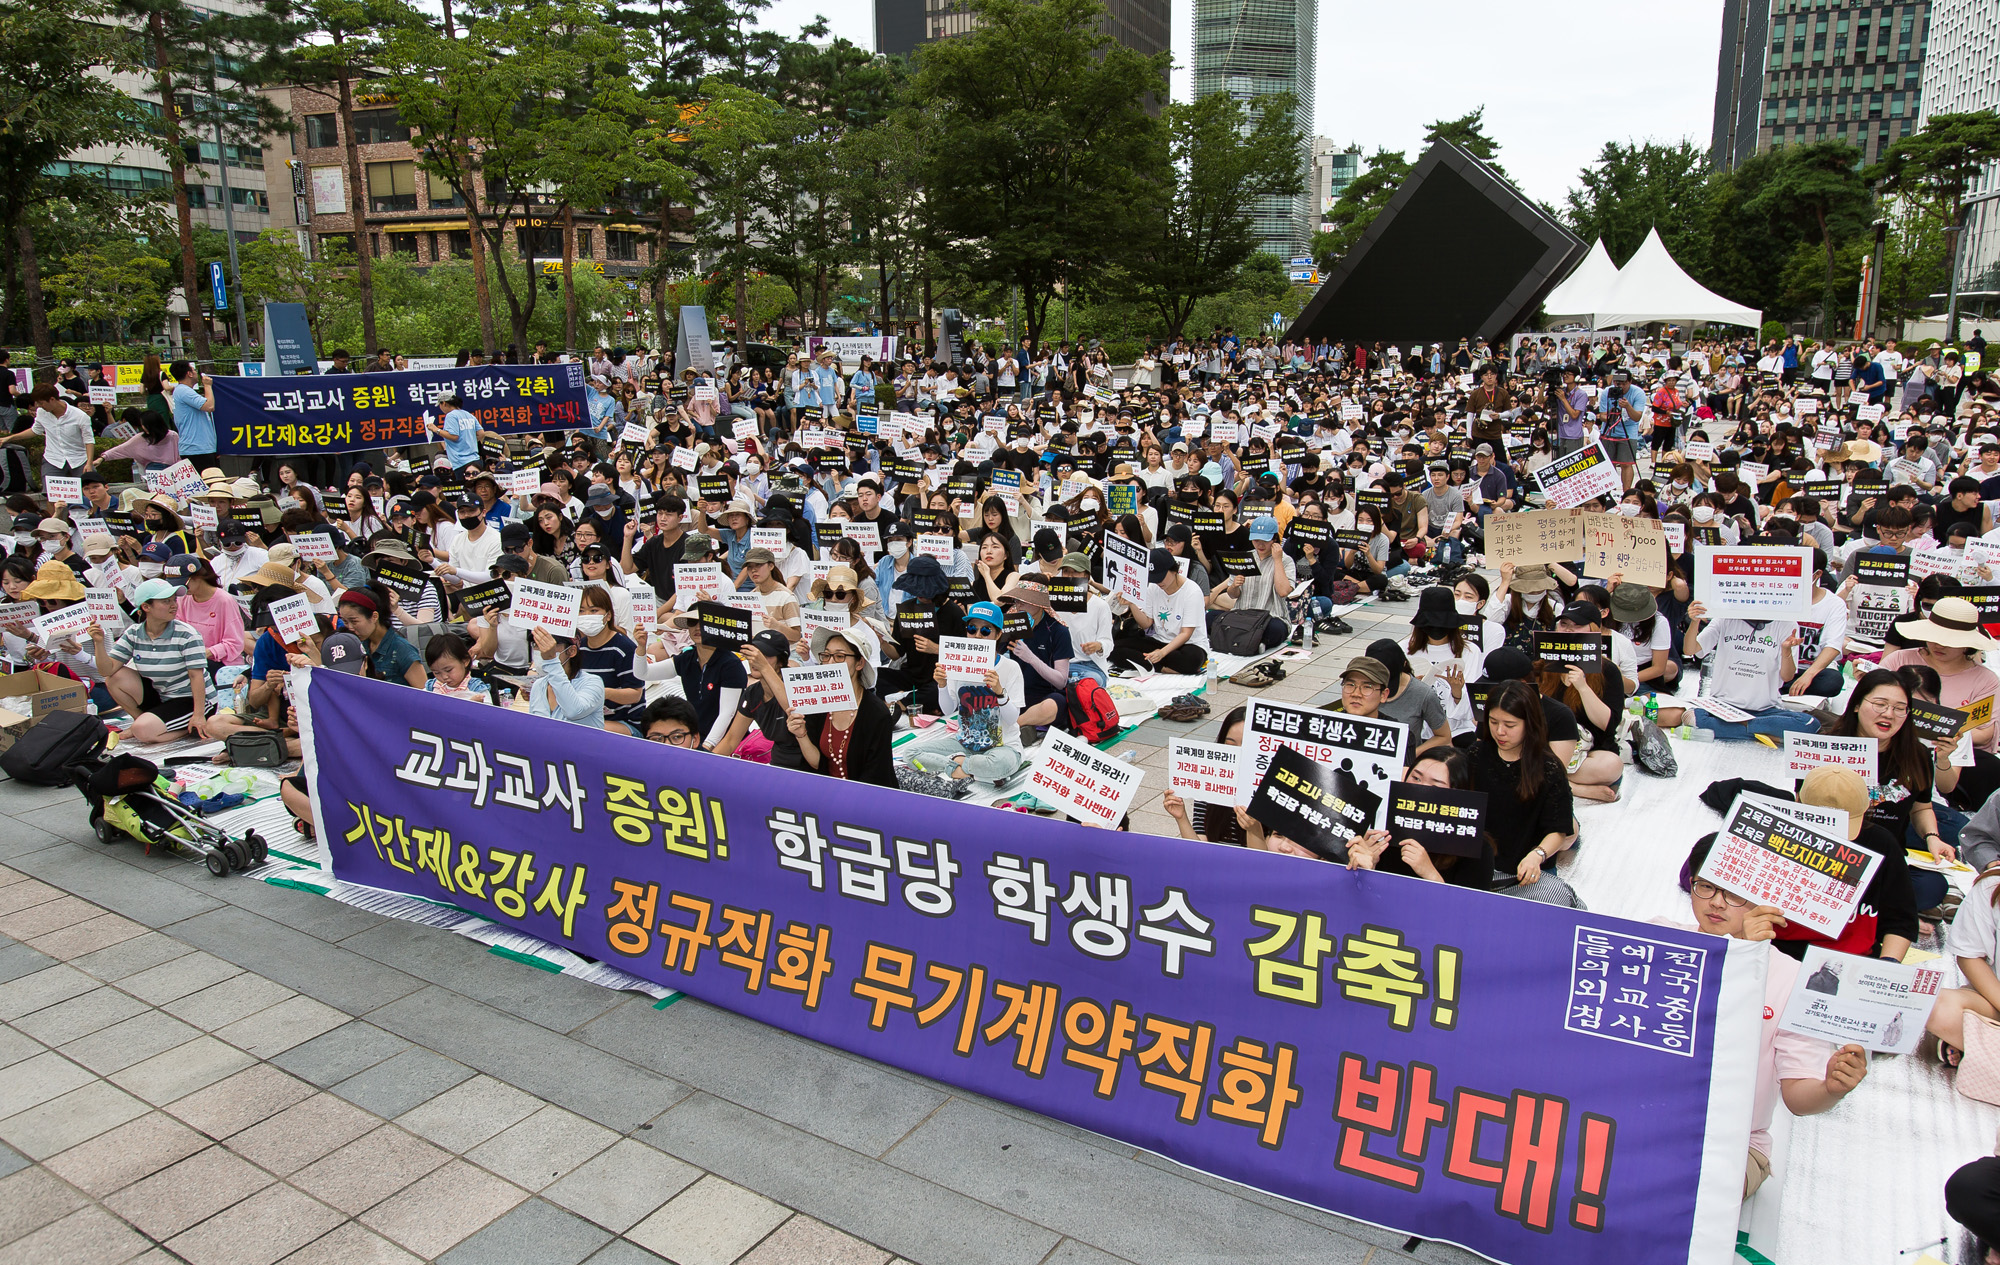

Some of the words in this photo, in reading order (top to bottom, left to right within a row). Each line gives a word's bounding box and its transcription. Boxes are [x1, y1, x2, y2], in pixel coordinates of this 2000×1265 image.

[263, 387, 345, 413] 교과교사
[352, 385, 396, 409] 증원!
[463, 377, 511, 400] 학생수
[516, 377, 555, 397] 감축!
[231, 421, 353, 448] 기간제&강사
[538, 401, 581, 425] 반대!
[1583, 445, 1598, 457] No!
[1558, 455, 1599, 478] 백년지대계!
[1495, 523, 1522, 532] 기회는
[1537, 517, 1576, 529] 평등하게
[1495, 534, 1522, 545] 과정은
[1539, 528, 1576, 540] 공정하게
[1596, 531, 1614, 548] 174
[1630, 535, 1656, 549] 7000
[1495, 547, 1523, 558] 결과는
[1540, 539, 1575, 552] 정의롭게
[519, 584, 546, 598] 교육계의
[546, 589, 574, 603] 정유라!!
[519, 598, 539, 609] 기간제
[539, 601, 554, 612] 교사,
[556, 604, 571, 615] 강사
[513, 609, 539, 622] 정규직화
[541, 615, 572, 629] 결사반대!
[703, 614, 714, 622] 교과
[714, 615, 726, 624] 교사
[726, 617, 749, 629] 증원하라
[703, 626, 719, 636] 학급당
[720, 629, 735, 640] 학생수
[736, 632, 749, 642] 감축
[1724, 634, 1750, 642] ENJOY
[944, 642, 966, 650] 교육계의
[967, 644, 989, 652] 정유라!!
[1540, 642, 1554, 650] 교과
[1555, 642, 1568, 651] 교사
[1569, 643, 1597, 651] 증원하라
[1734, 645, 1765, 654] VACATION
[945, 653, 961, 661] 기간제
[962, 655, 975, 663] 교사,
[1540, 653, 1560, 661] 학급당
[1561, 653, 1582, 662] 학생수
[1583, 654, 1597, 662] 감축
[789, 671, 814, 682] 교육계의
[815, 667, 843, 680] 정유라!!
[792, 685, 813, 694] 기간제
[813, 683, 829, 693] 교사,
[830, 681, 844, 691] 강사
[791, 697, 818, 708] 정규직화
[821, 694, 850, 705] 결사반대!
[1923, 712, 1957, 726] 증원하라
[1971, 702, 1990, 720] 확보
[1255, 706, 1303, 734] 학급당
[1308, 716, 1357, 743] 학생수
[1363, 726, 1396, 752] 감소
[1933, 725, 1951, 735] 감축
[1304, 745, 1333, 763] 티오
[1792, 738, 1828, 750] 교육계의
[1830, 742, 1867, 752] 정유라!!
[1052, 739, 1091, 766] 교육계의
[1091, 759, 1130, 785] 정유라!!
[1176, 746, 1205, 759] 교육계의
[1207, 750, 1236, 764] 정유라!!
[1795, 750, 1821, 762] 기간제
[1823, 754, 1844, 764] 교사,
[1847, 756, 1866, 765] 강사
[1045, 757, 1075, 779] 기간제
[1074, 772, 1096, 793] 교사,
[1099, 784, 1120, 802] 강사
[1177, 761, 1198, 774] 기간제
[1200, 765, 1217, 778] 교사,
[1219, 768, 1235, 780] 강사
[1172, 776, 1201, 790] 정규직화
[1204, 781, 1237, 797] 결사반대!
[1275, 766, 1300, 788] 교과
[1297, 778, 1322, 801] 교사
[1320, 791, 1366, 824] 증원하라
[1032, 771, 1070, 799] 정규직화
[1073, 793, 1117, 822] 결사반대!
[1266, 785, 1300, 813] 학급당
[1298, 803, 1332, 830] 학생수
[1331, 821, 1357, 841] 감축
[1396, 798, 1416, 811] 교과
[1418, 802, 1438, 815] 교사
[1440, 805, 1479, 820] 증원하라
[1794, 810, 1836, 826] 정유라!!
[1394, 815, 1424, 830] 학급당
[1426, 820, 1454, 834] 학생수
[1456, 824, 1477, 837] 감축
[1741, 806, 1773, 827] 교육은
[1774, 821, 1835, 854] 5년지소계?
[1835, 846, 1866, 868] No!
[1734, 822, 1766, 843] 교육은
[1768, 833, 1848, 879] 백년지대계!
[1750, 846, 1760, 855] 당
[1762, 850, 1779, 862] 학생
[1782, 860, 1790, 868] 수
[1792, 865, 1815, 878] 감소!
[394, 729, 587, 831] 교과교사
[603, 773, 731, 861] 증원!
[767, 809, 961, 916] 학급당
[985, 853, 1214, 976] 학생수
[1247, 906, 1459, 1028] 감축!
[1761, 861, 1798, 881] 교육예산
[1800, 878, 1821, 891] 확보!
[1742, 882, 1759, 895] 시험
[1761, 891, 1779, 904] 통한
[1781, 900, 1808, 916] 정교사
[1809, 911, 1831, 926] 증원!
[1786, 892, 1808, 906] 개혁!
[1804, 890, 1843, 910] 수급조정!
[1572, 934, 1615, 1029] 들의외침
[1890, 983, 1910, 993] 티오
[1610, 945, 1655, 1038] 예비교사
[1652, 951, 1698, 1048] 전국중등
[344, 800, 589, 938] 기간제&강사
[606, 880, 833, 1009] 정규직화
[853, 942, 1299, 1147] 무기계약직화
[1336, 1056, 1612, 1229] 반대!
